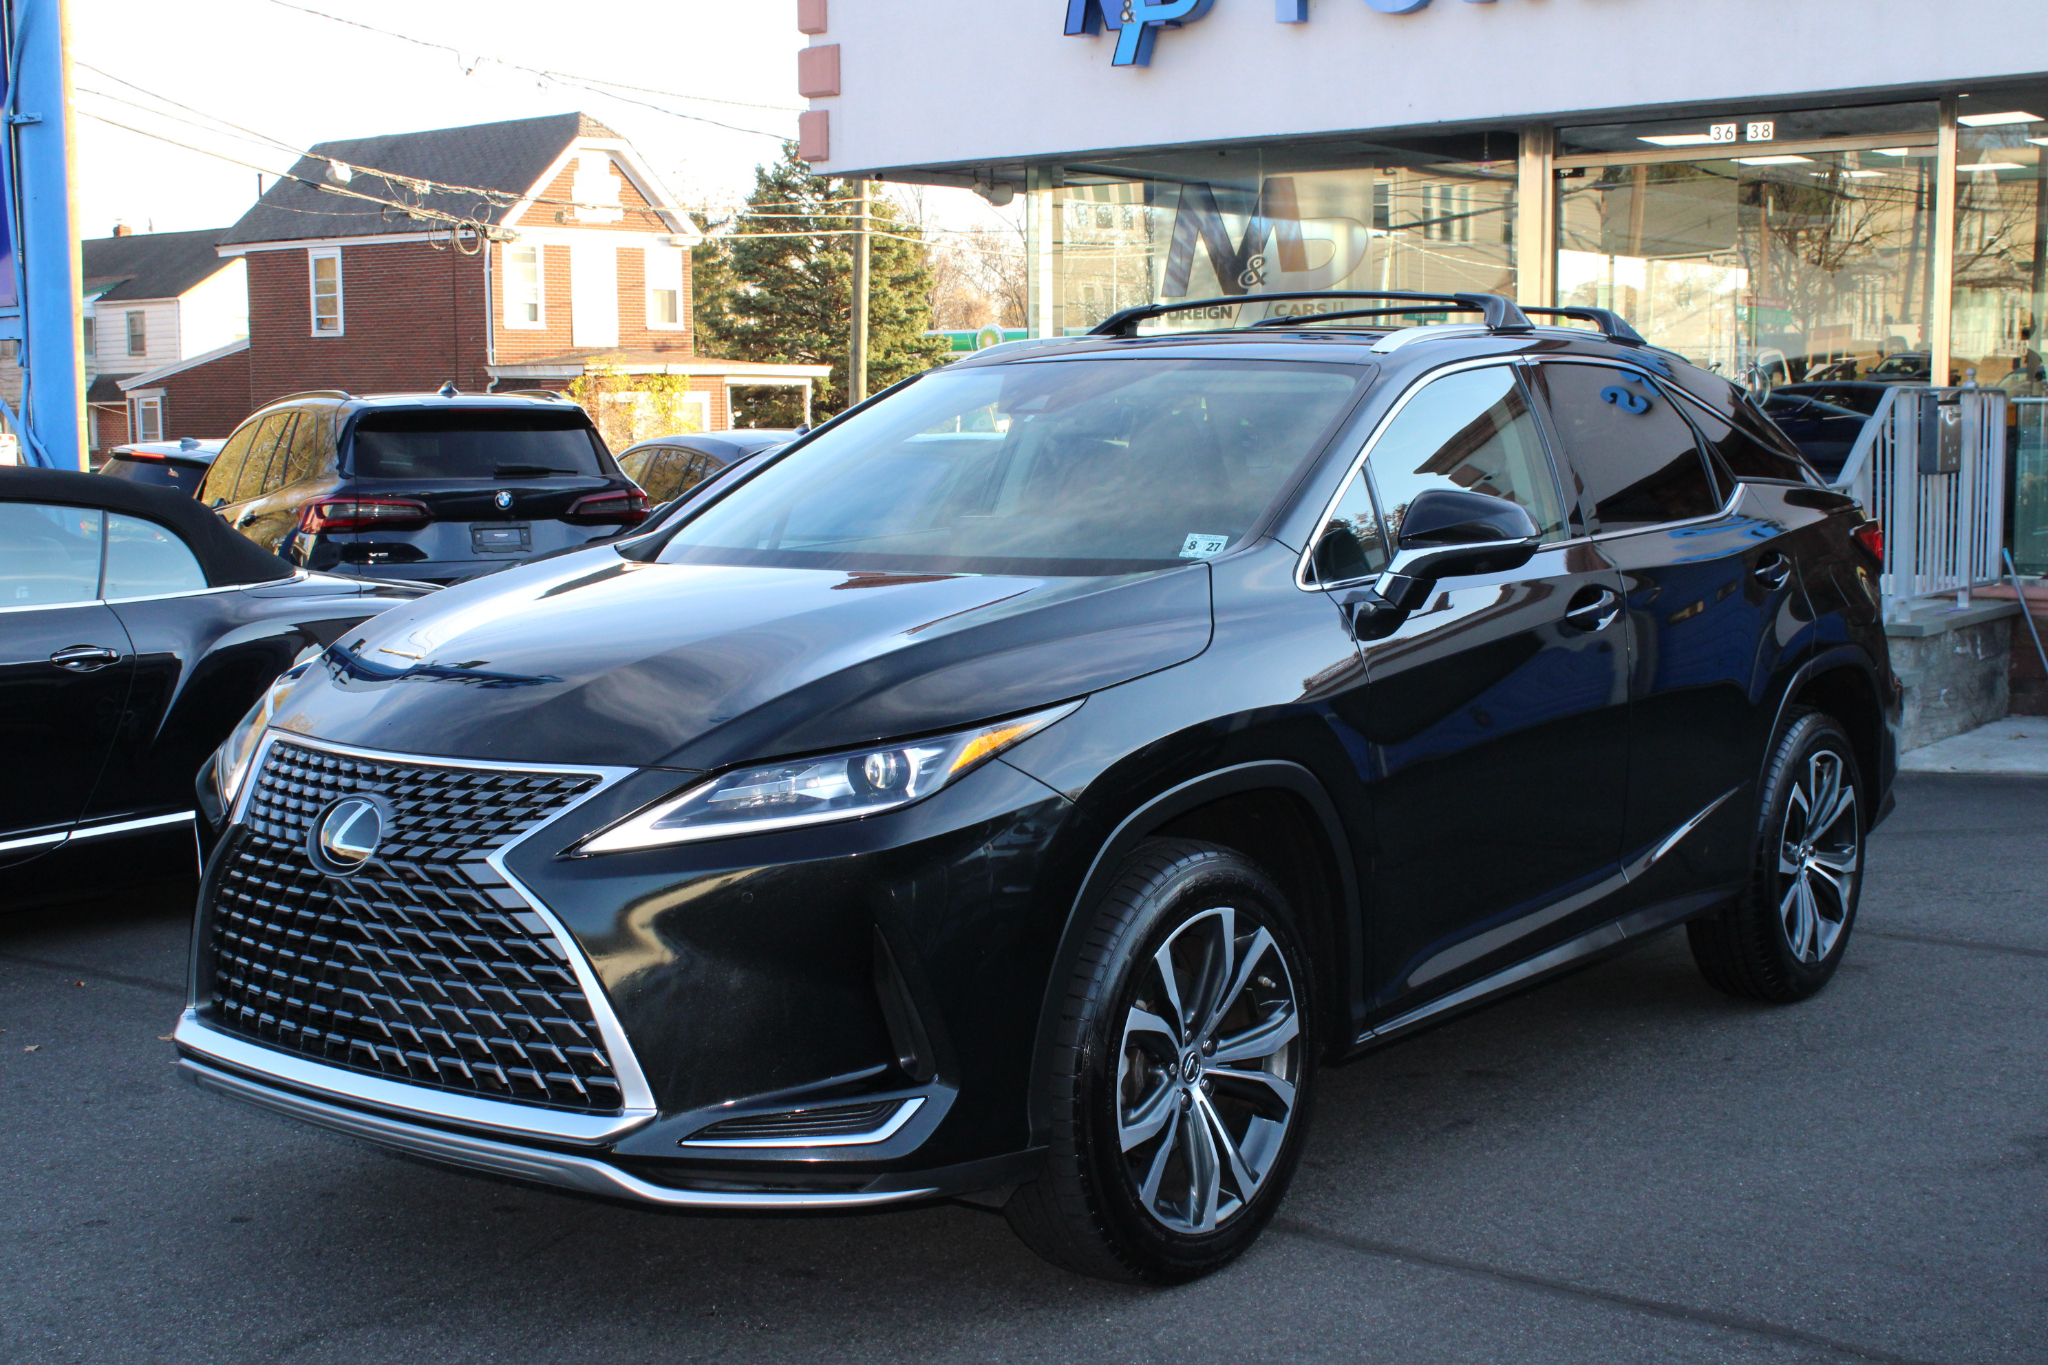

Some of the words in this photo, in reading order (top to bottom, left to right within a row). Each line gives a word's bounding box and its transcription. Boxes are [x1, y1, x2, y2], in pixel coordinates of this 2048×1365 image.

[1713, 126, 1734, 141] 36
[1750, 124, 1771, 139] 38
[1274, 303, 1327, 318] CARS
[1188, 541, 1197, 550] 8
[1206, 542, 1221, 552] 27
